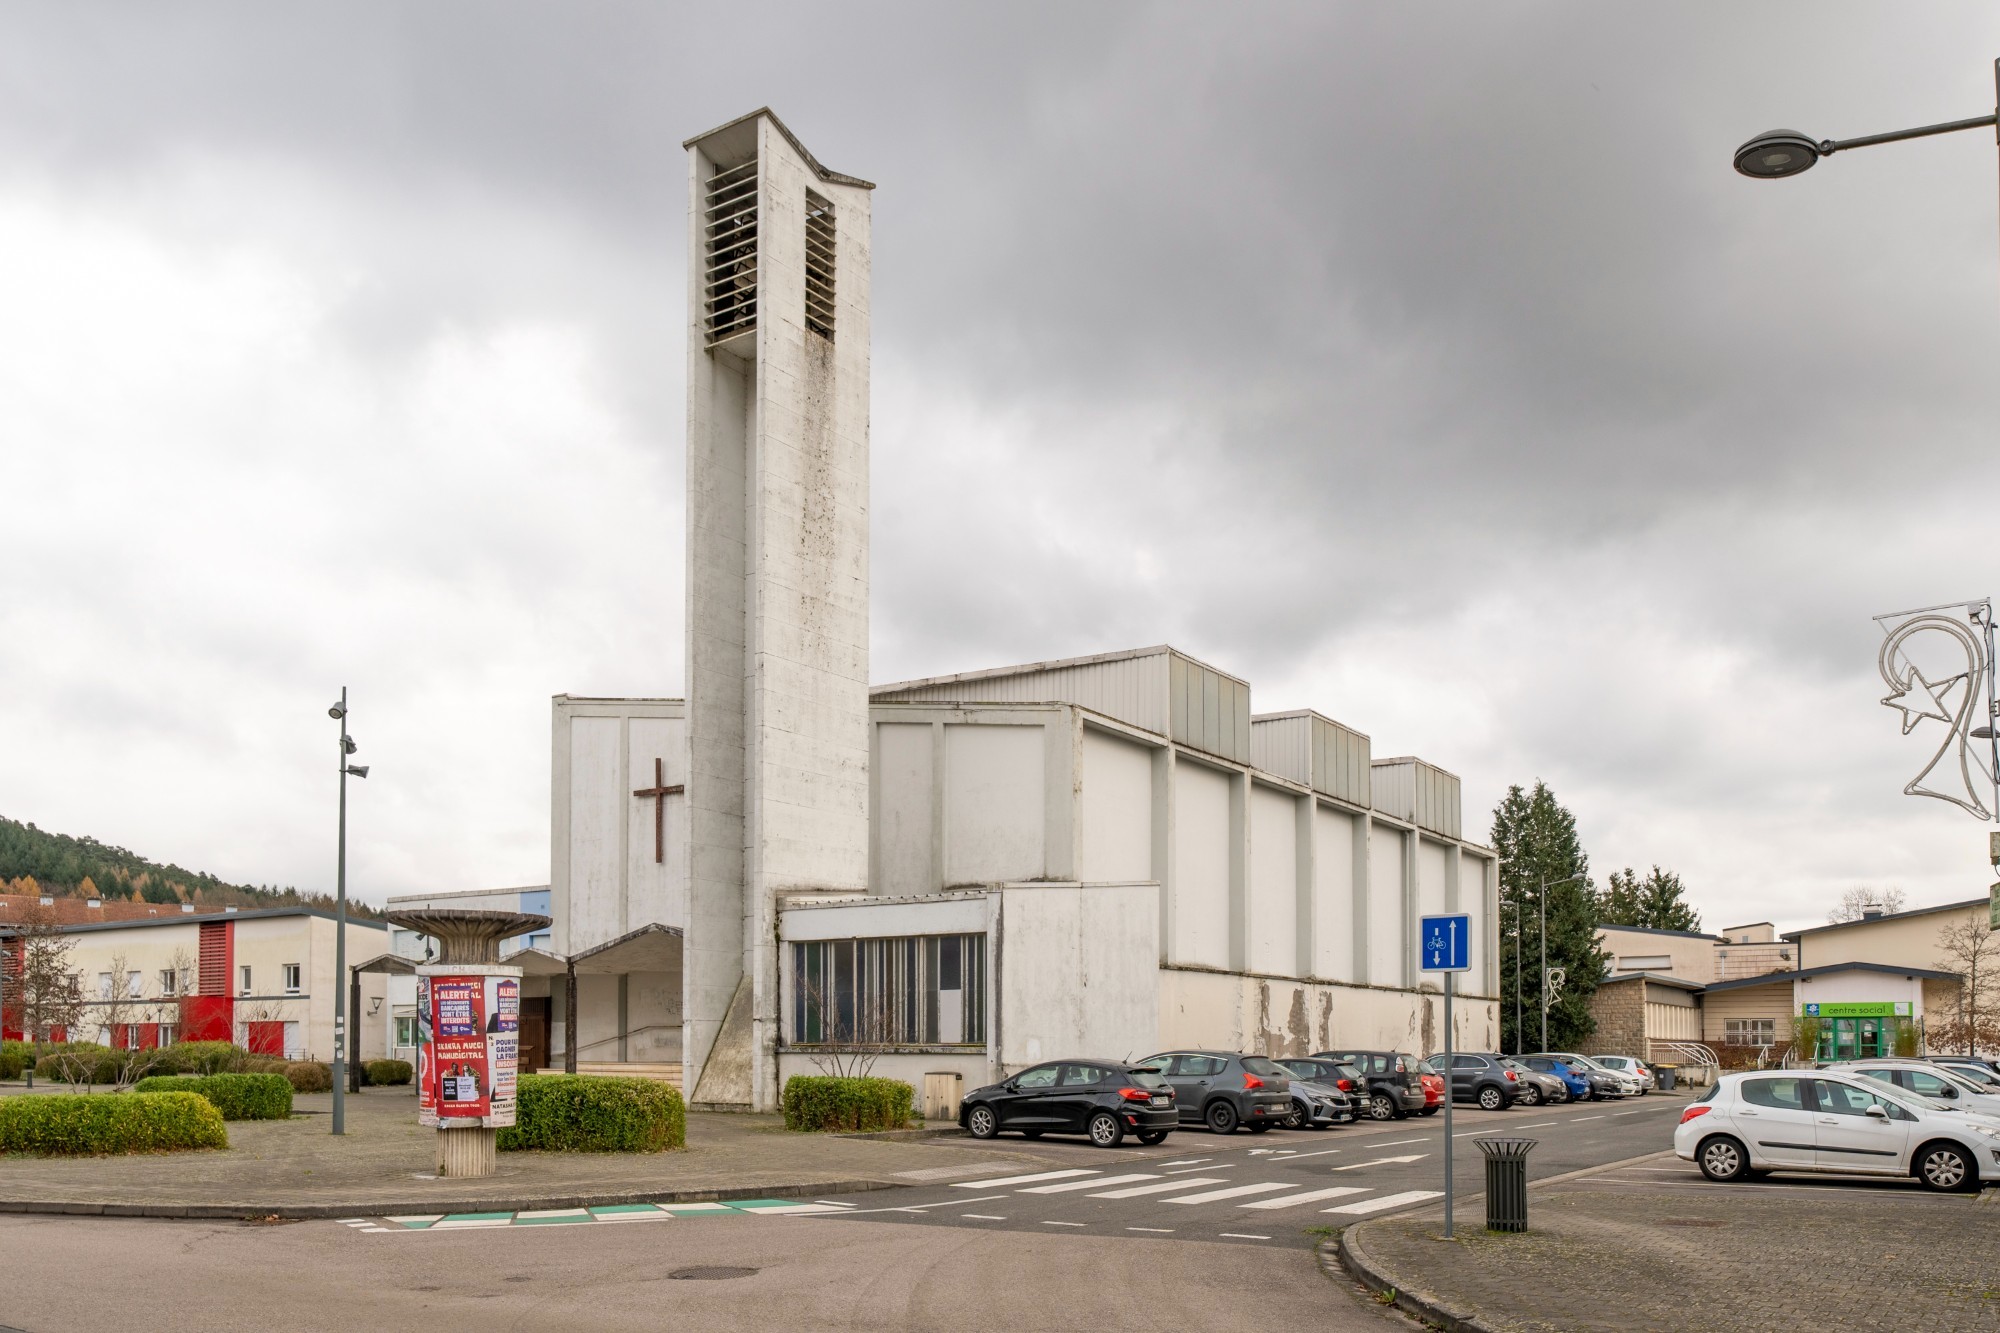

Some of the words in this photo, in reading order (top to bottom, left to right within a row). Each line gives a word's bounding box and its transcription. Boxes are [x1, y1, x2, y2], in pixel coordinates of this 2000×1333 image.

[440, 990, 470, 1000] ALERTE
[1859, 1005, 1886, 1013] social
[438, 1051, 484, 1059] MANUDIGITAL
